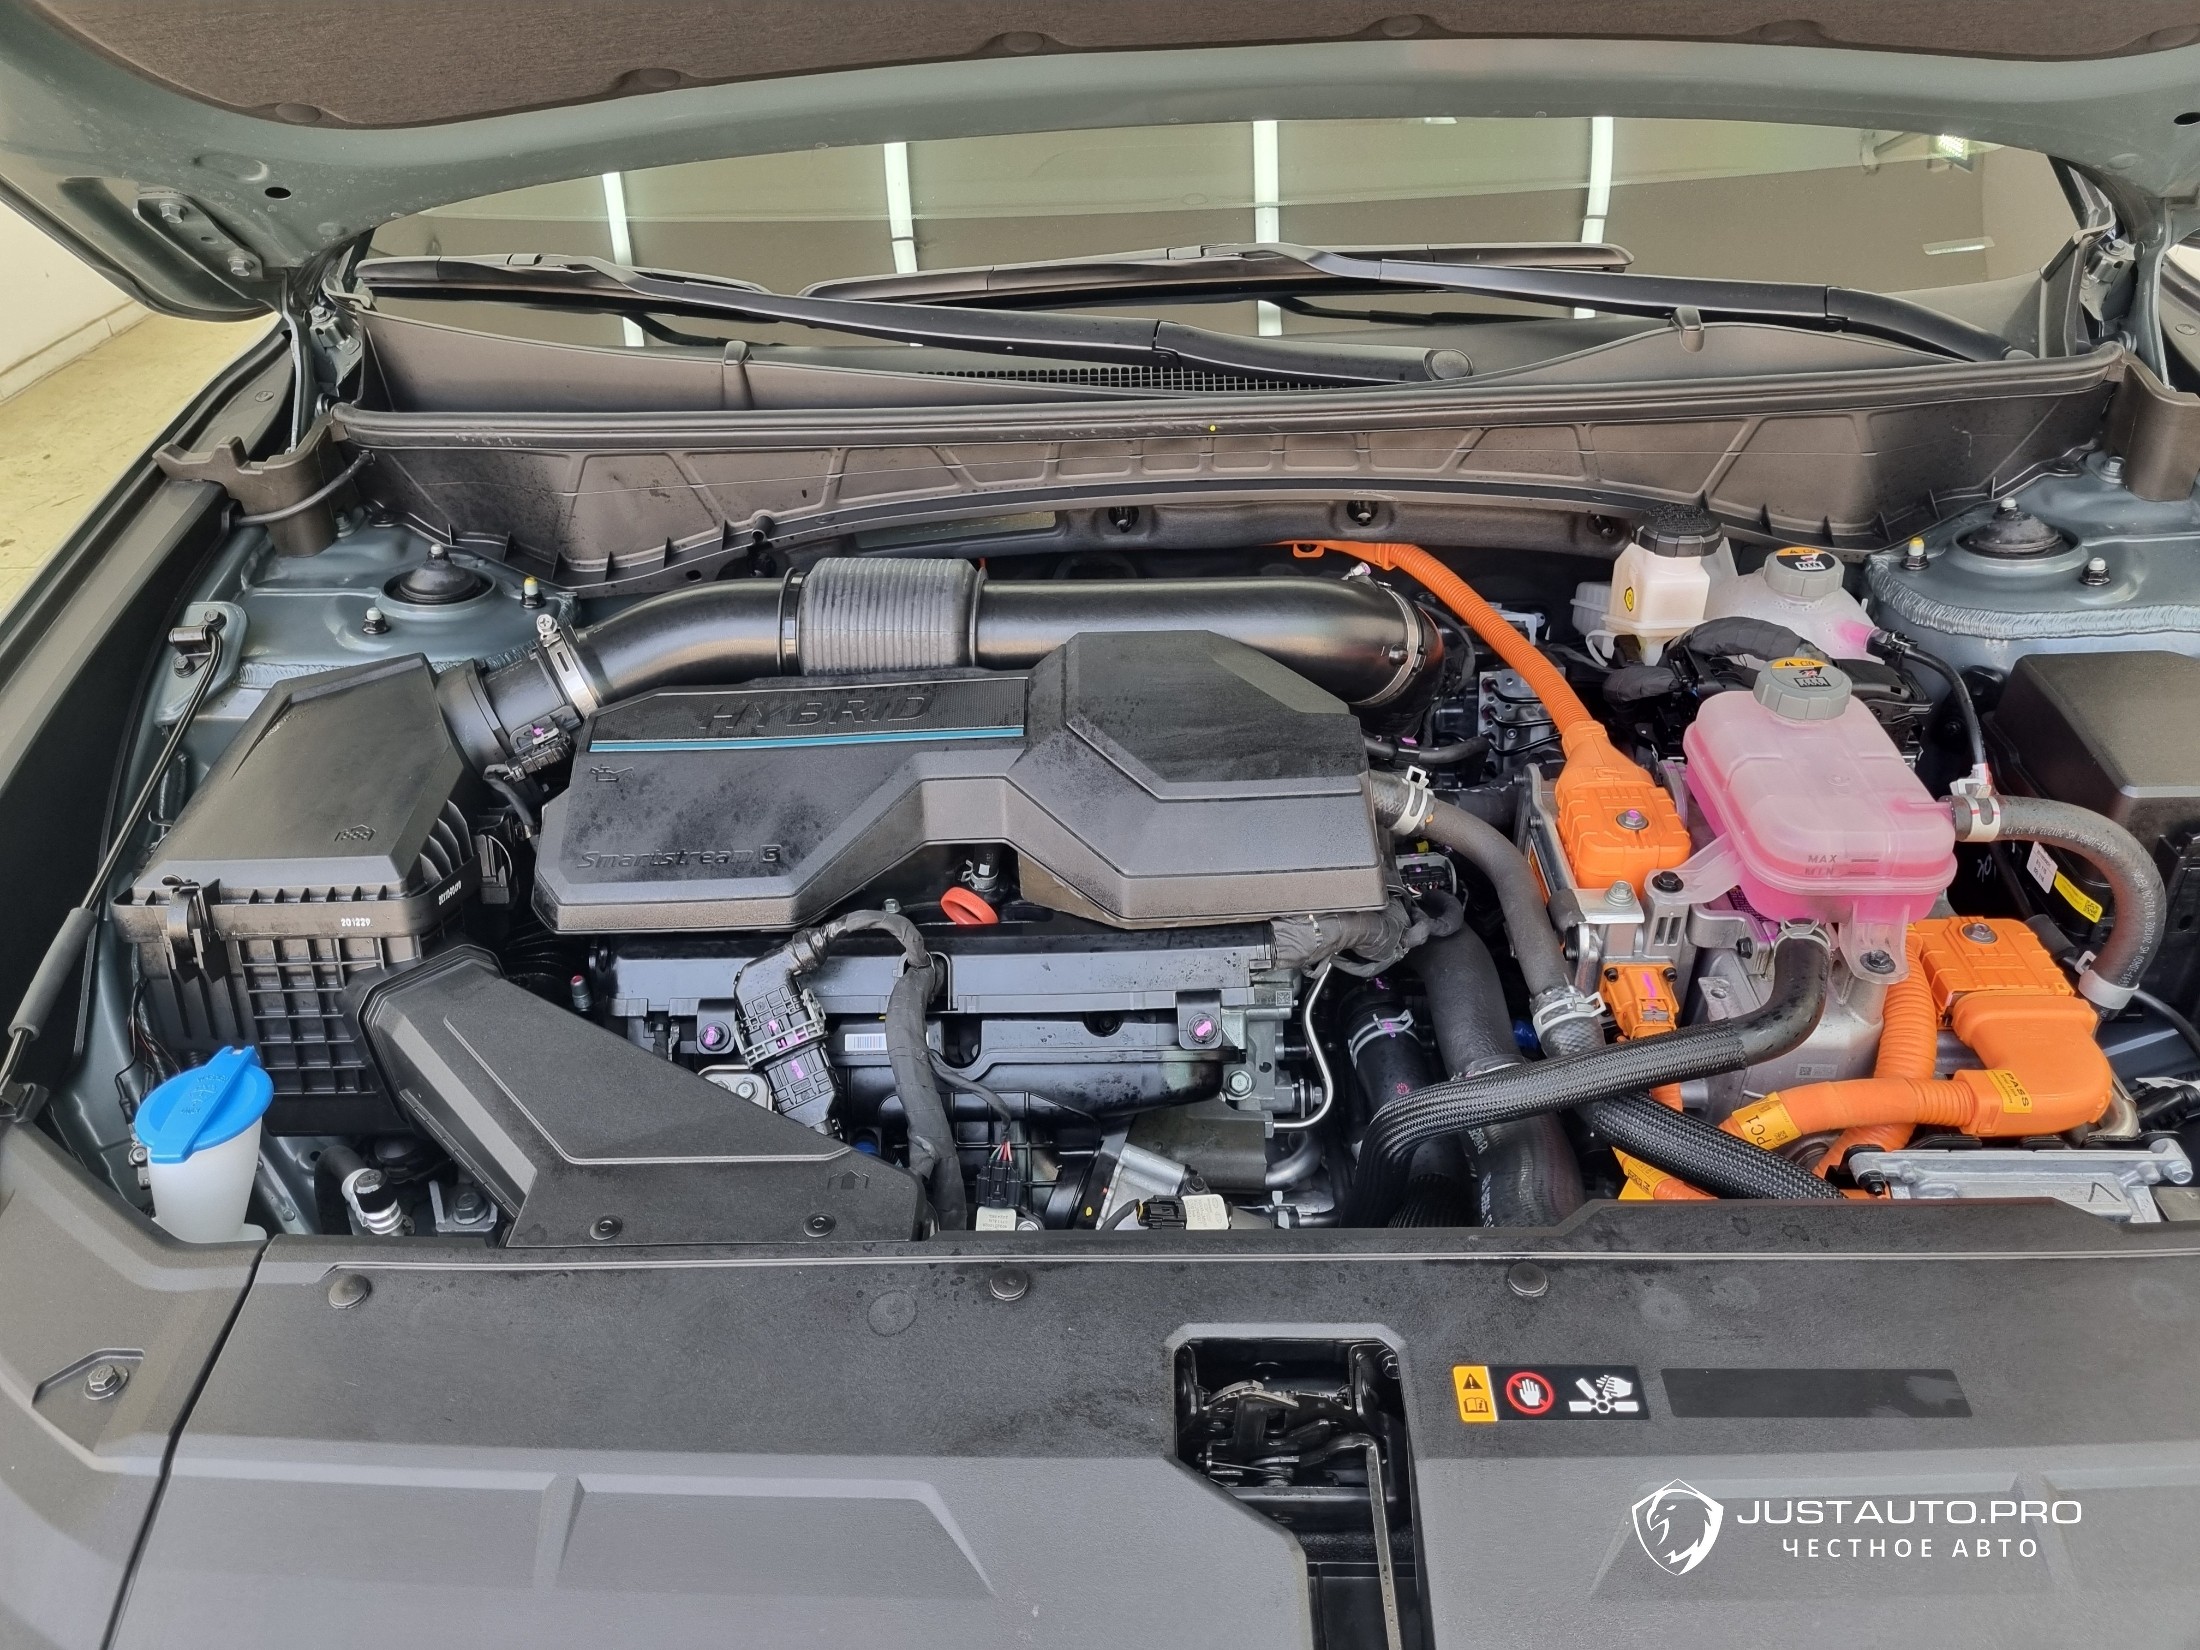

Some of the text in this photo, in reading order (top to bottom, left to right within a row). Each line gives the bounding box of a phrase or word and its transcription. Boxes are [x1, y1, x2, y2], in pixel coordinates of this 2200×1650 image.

[698, 696, 931, 730] HYBRID
[577, 849, 753, 868] Smartstream
[1807, 854, 1837, 864] MAX
[1804, 867, 1834, 876] MIN
[2004, 1071, 2030, 1108] PASS
